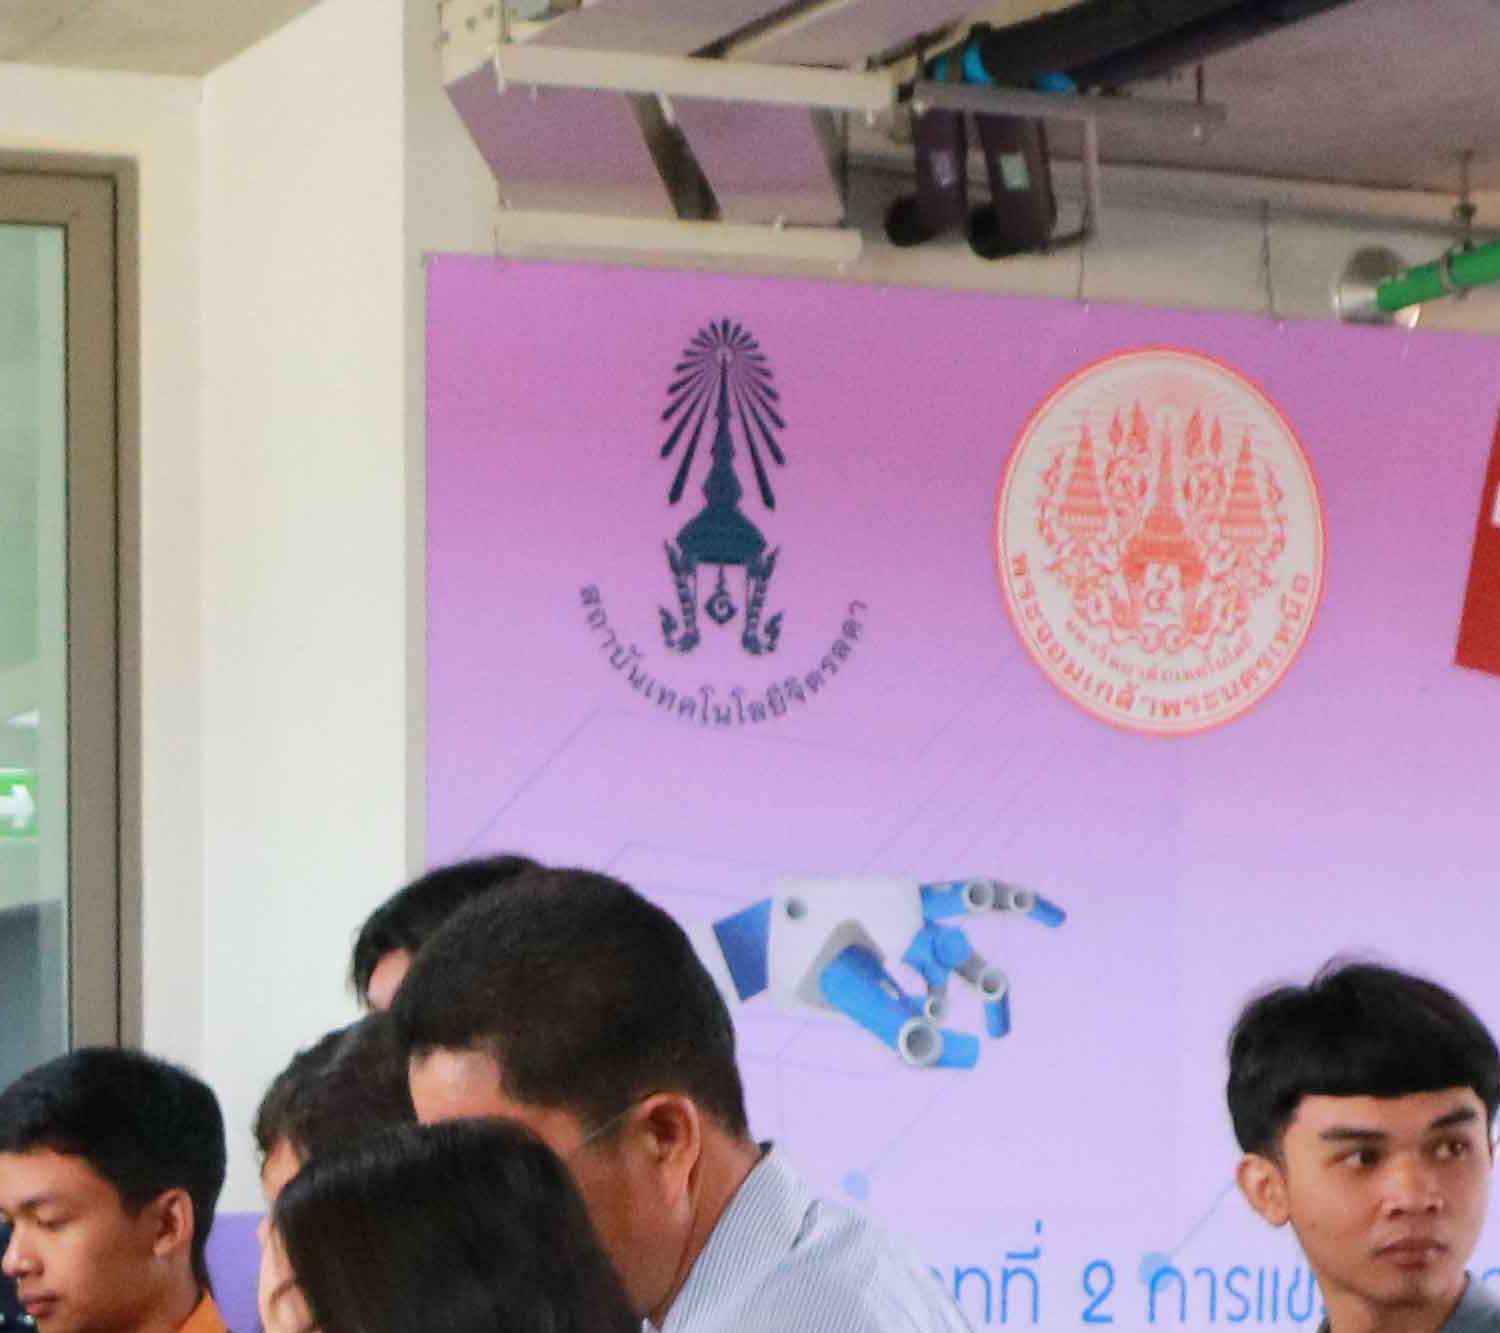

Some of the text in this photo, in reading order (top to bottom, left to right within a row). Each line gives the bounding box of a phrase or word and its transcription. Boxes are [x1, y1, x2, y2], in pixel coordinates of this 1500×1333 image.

[928, 1219, 1042, 1325] ทที่
[1080, 1259, 1117, 1324] 2
[1147, 1264, 1326, 1325] การแข
